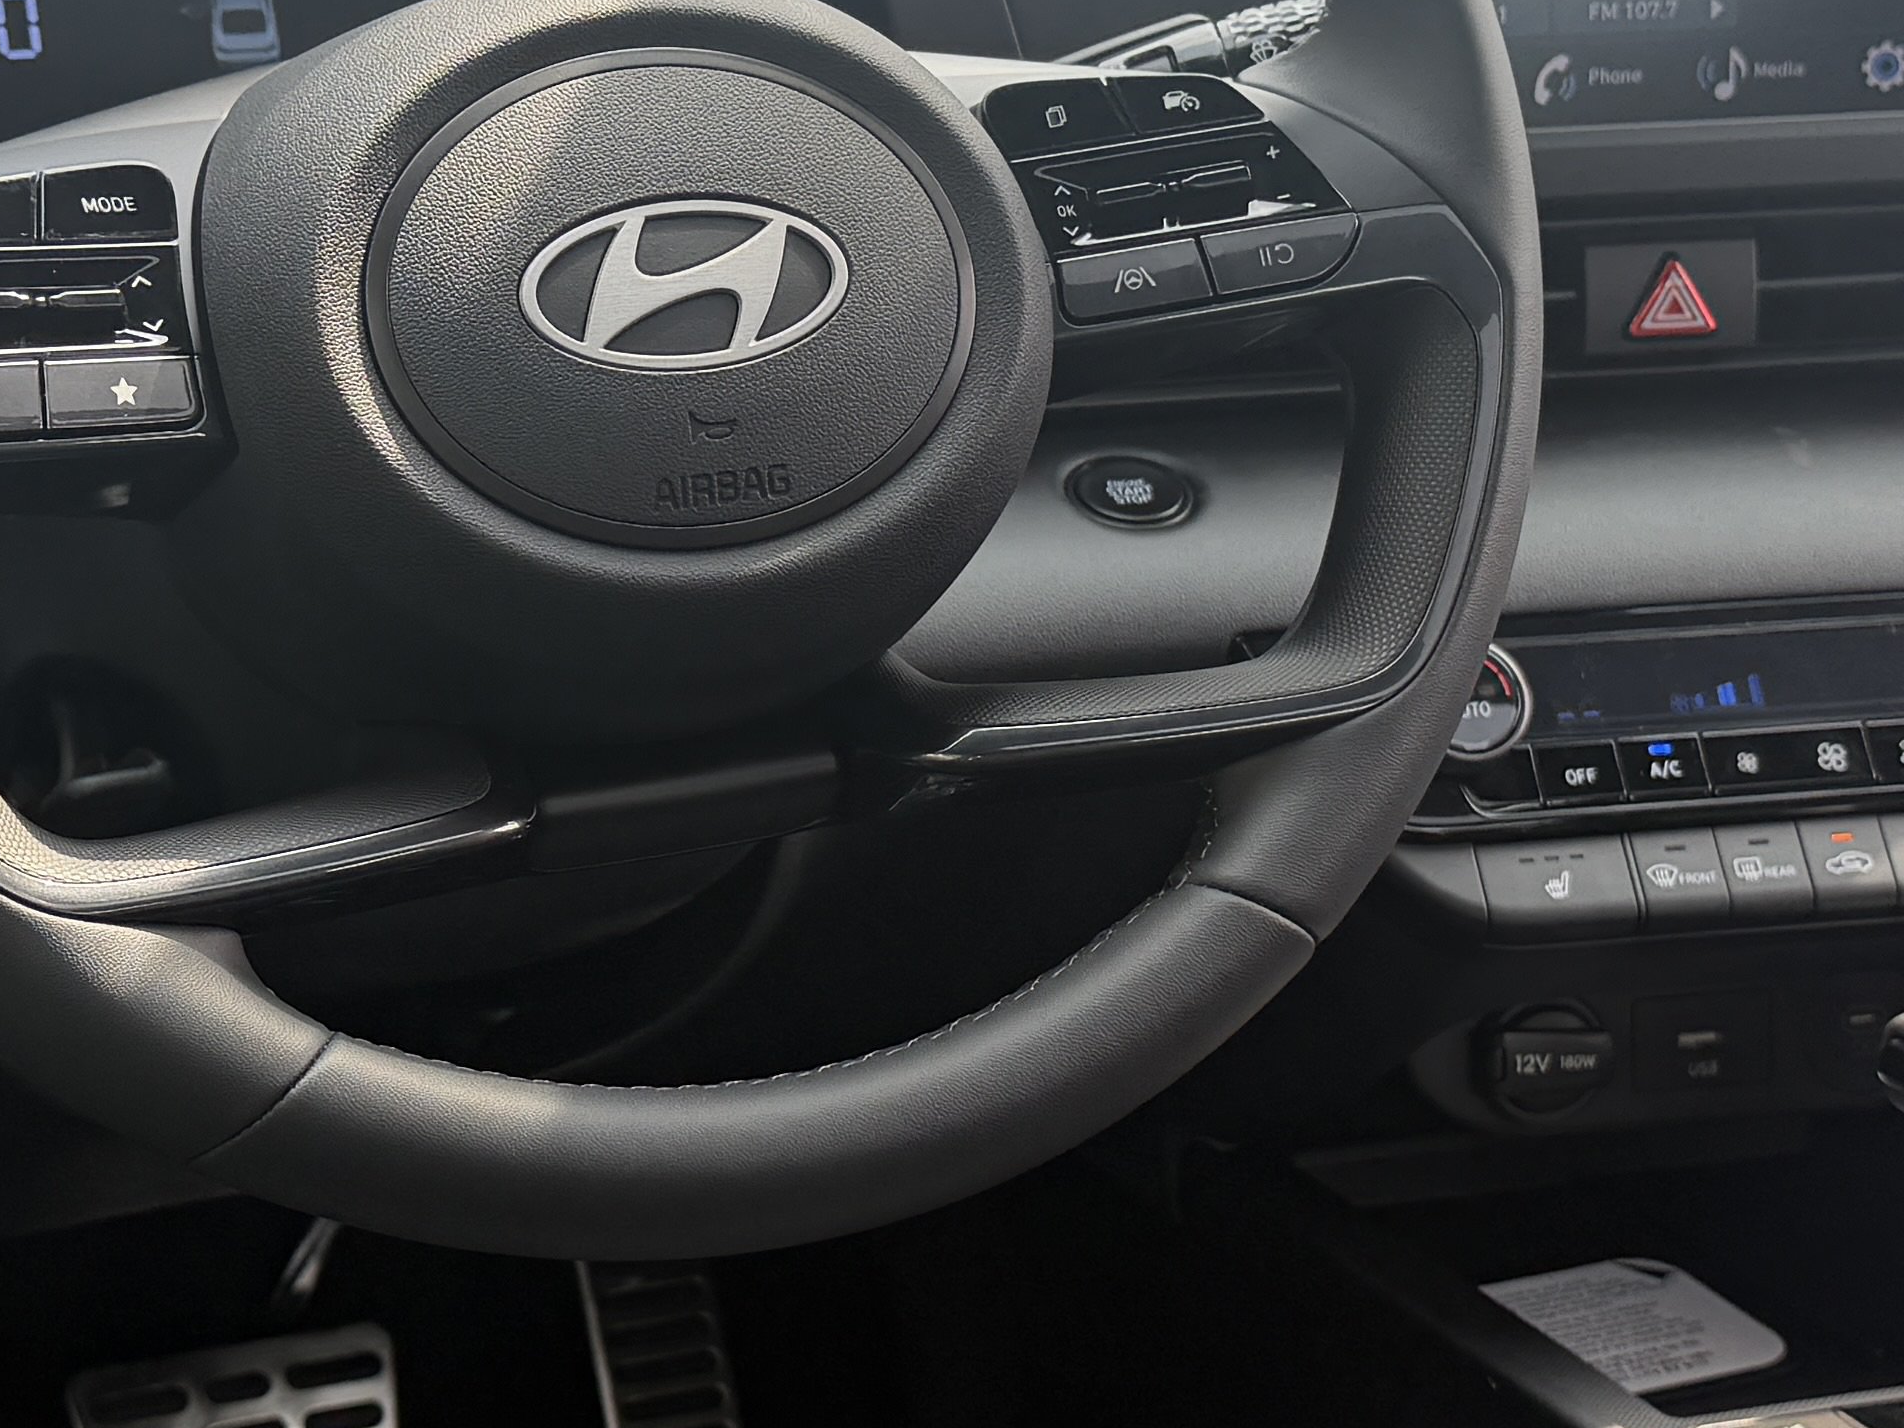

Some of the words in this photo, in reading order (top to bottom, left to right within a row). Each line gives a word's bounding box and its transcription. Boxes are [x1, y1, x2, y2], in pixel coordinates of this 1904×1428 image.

[1589, 1, 1617, 21] FM
[1625, 0, 1679, 20] 107.7
[1589, 66, 1644, 85] Phone
[1754, 59, 1807, 78] Media
[81, 196, 138, 214] MODE
[1056, 202, 1078, 219] OK
[654, 464, 793, 511] AIRBAG
[1462, 700, 1492, 719] UTO
[1564, 766, 1599, 787] OFF
[1650, 759, 1683, 779] A/C
[1679, 870, 1718, 885] FRONT
[1515, 1053, 1551, 1075] 12V
